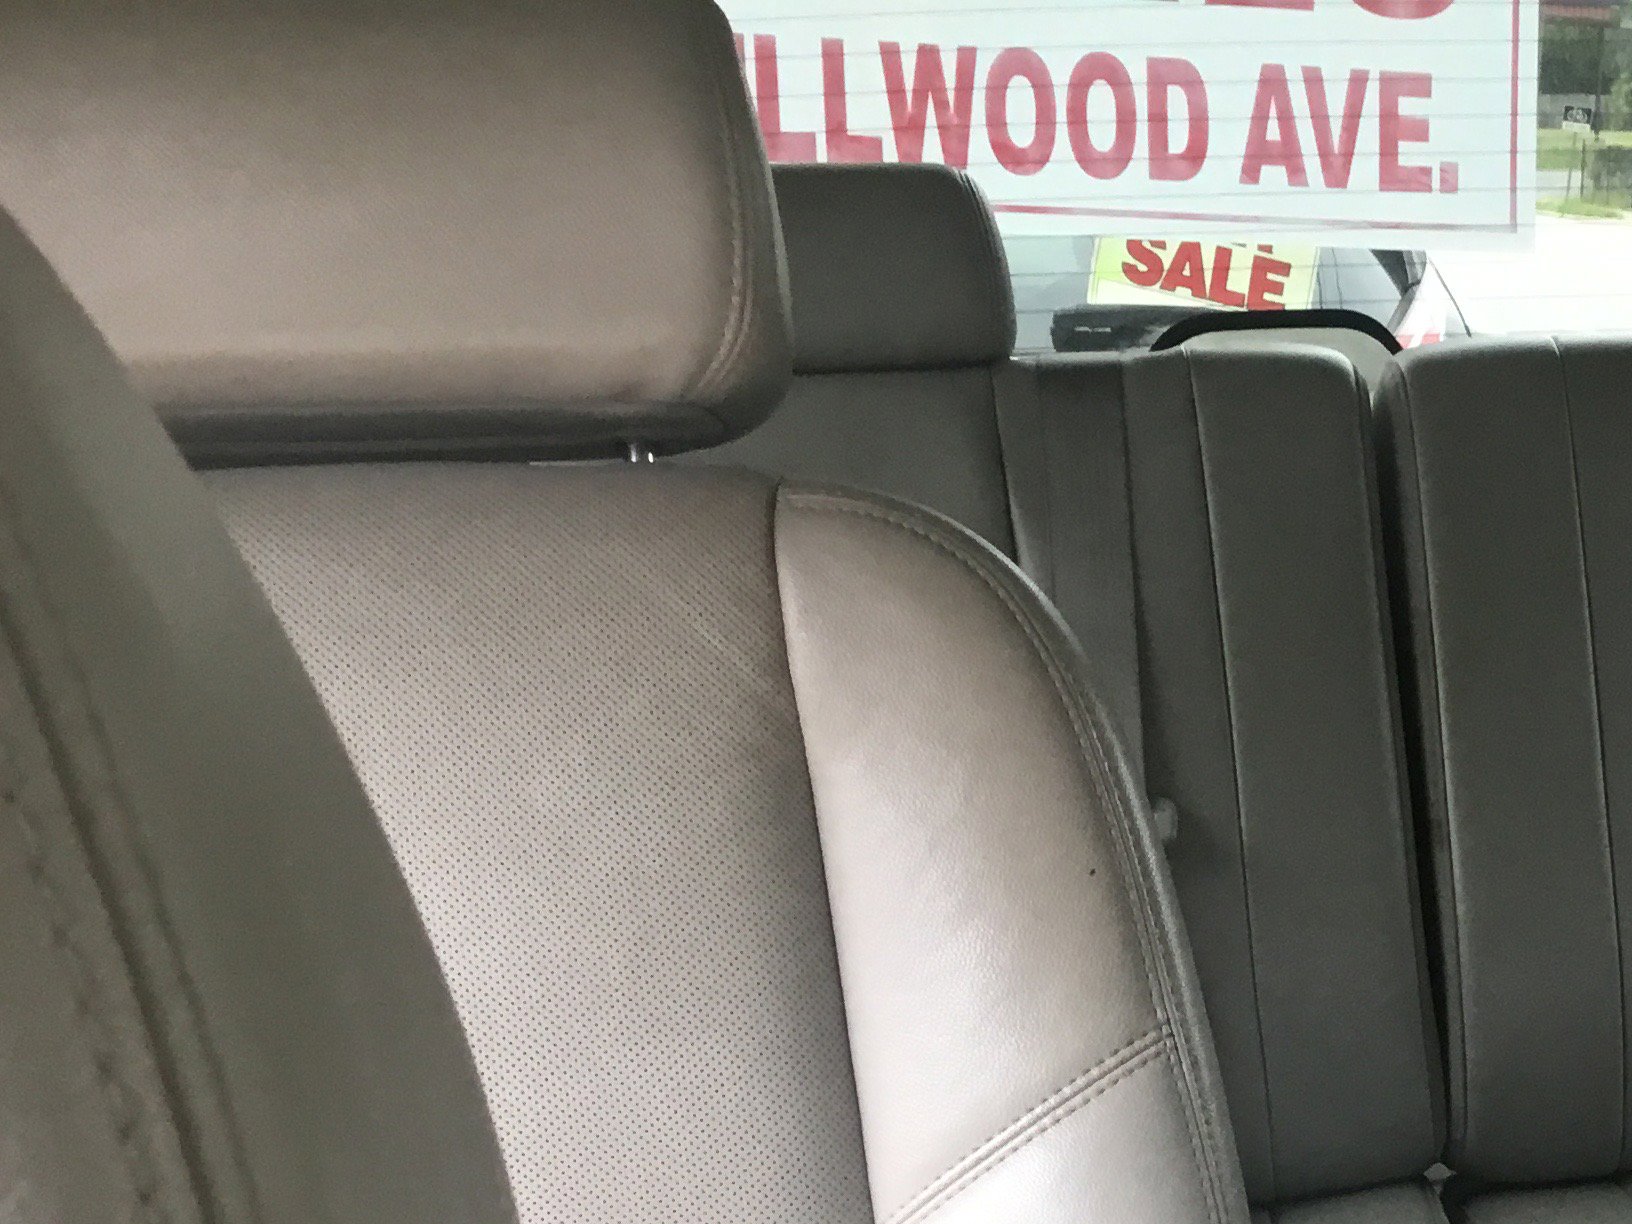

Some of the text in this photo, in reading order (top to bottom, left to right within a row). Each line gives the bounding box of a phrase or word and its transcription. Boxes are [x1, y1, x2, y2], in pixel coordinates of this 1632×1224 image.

[734, 33, 1459, 194] LLWOOD AVE.
[1122, 239, 1292, 311] SALE
